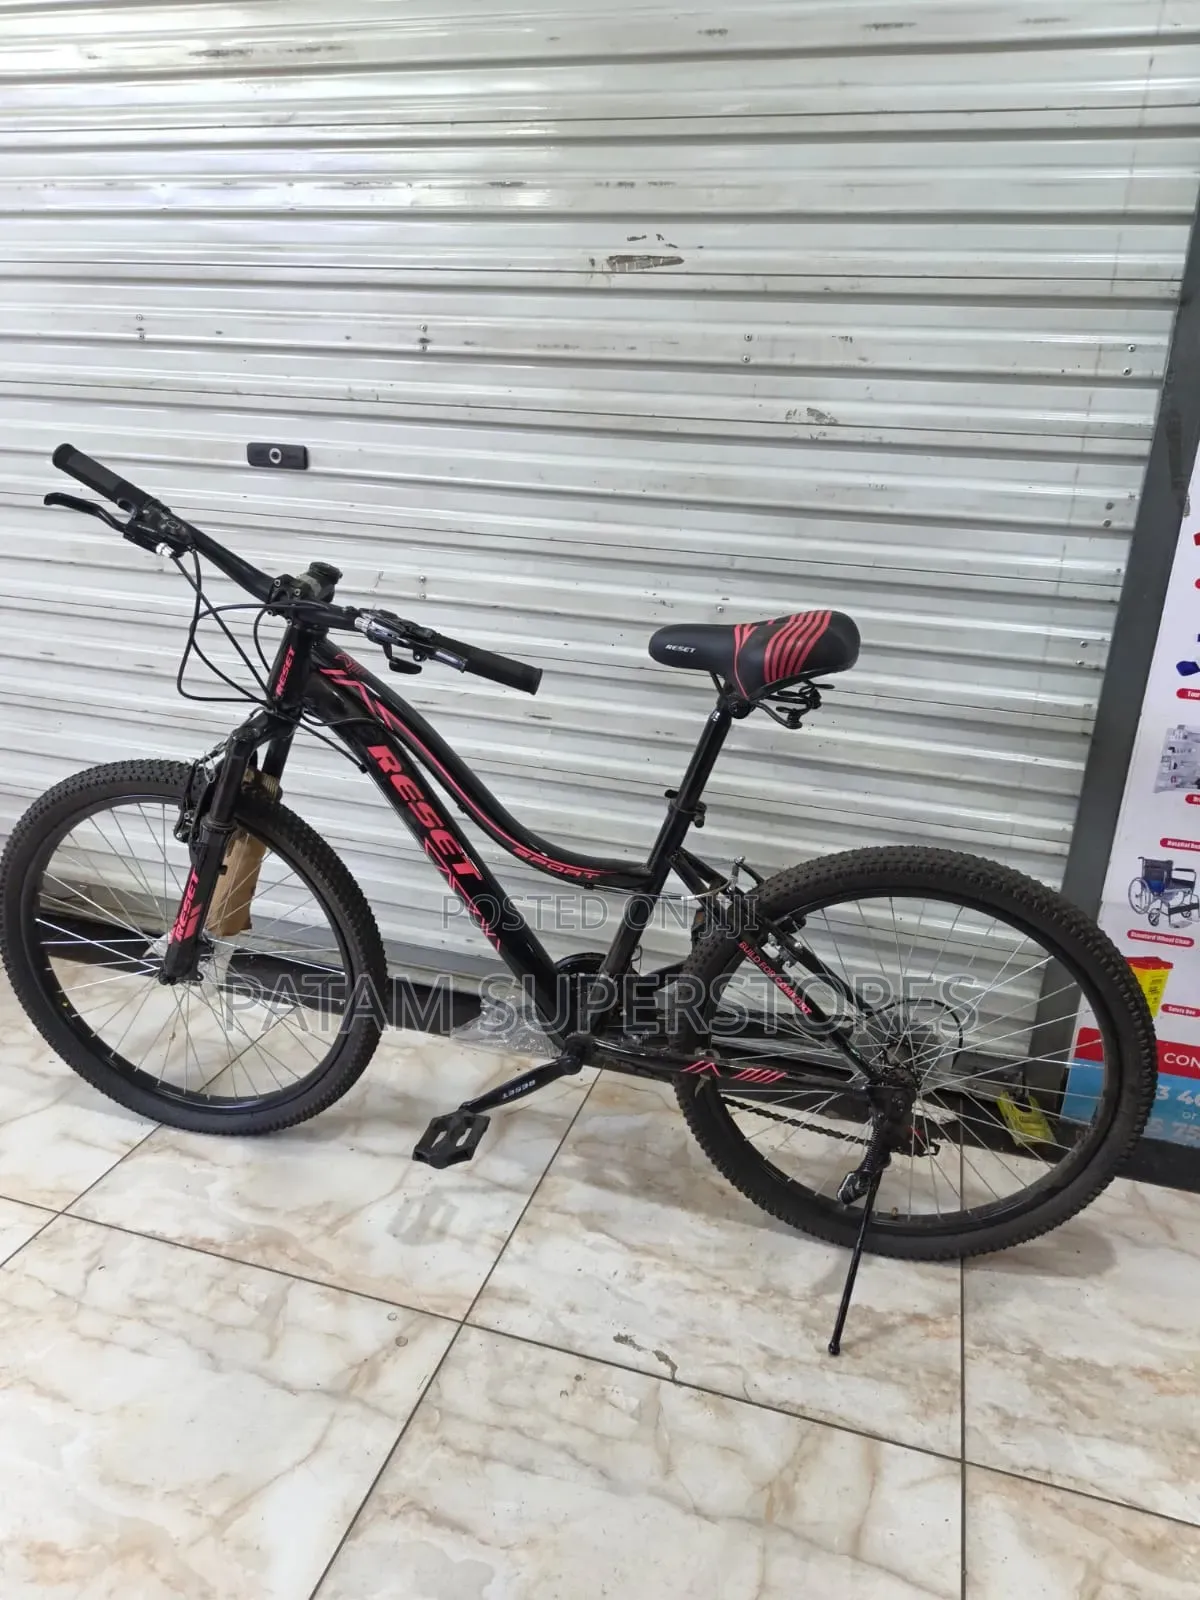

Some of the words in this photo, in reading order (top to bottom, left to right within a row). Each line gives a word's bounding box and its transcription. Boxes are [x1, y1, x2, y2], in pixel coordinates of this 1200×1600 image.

[275, 645, 295, 697] RESET
[665, 644, 696, 653] RESET
[366, 745, 483, 881] RESET
[511, 848, 601, 879] SPORT
[174, 867, 199, 942] RESET
[1130, 931, 1156, 941] Standard
[1156, 935, 1175, 944] Wheel
[739, 941, 761, 963] BUILD
[759, 960, 778, 978] FOR
[774, 976, 812, 1016] COMFORT
